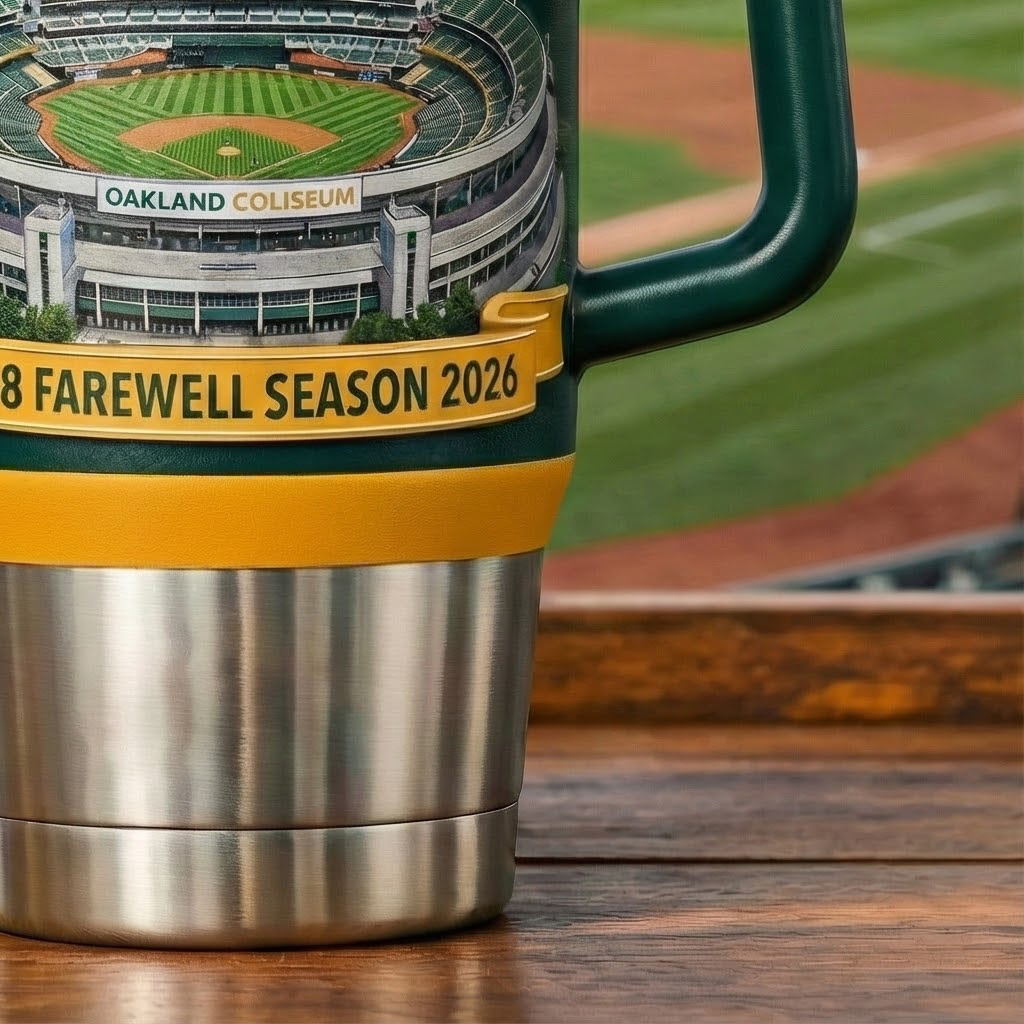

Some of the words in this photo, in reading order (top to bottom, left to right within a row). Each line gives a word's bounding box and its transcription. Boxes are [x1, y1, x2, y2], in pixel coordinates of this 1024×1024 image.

[105, 187, 226, 212] OAKLAND
[232, 186, 355, 212] COLISEUM
[35, 366, 253, 420] FAREWELL
[264, 365, 428, 420] SEASON
[440, 352, 519, 409] 2026
